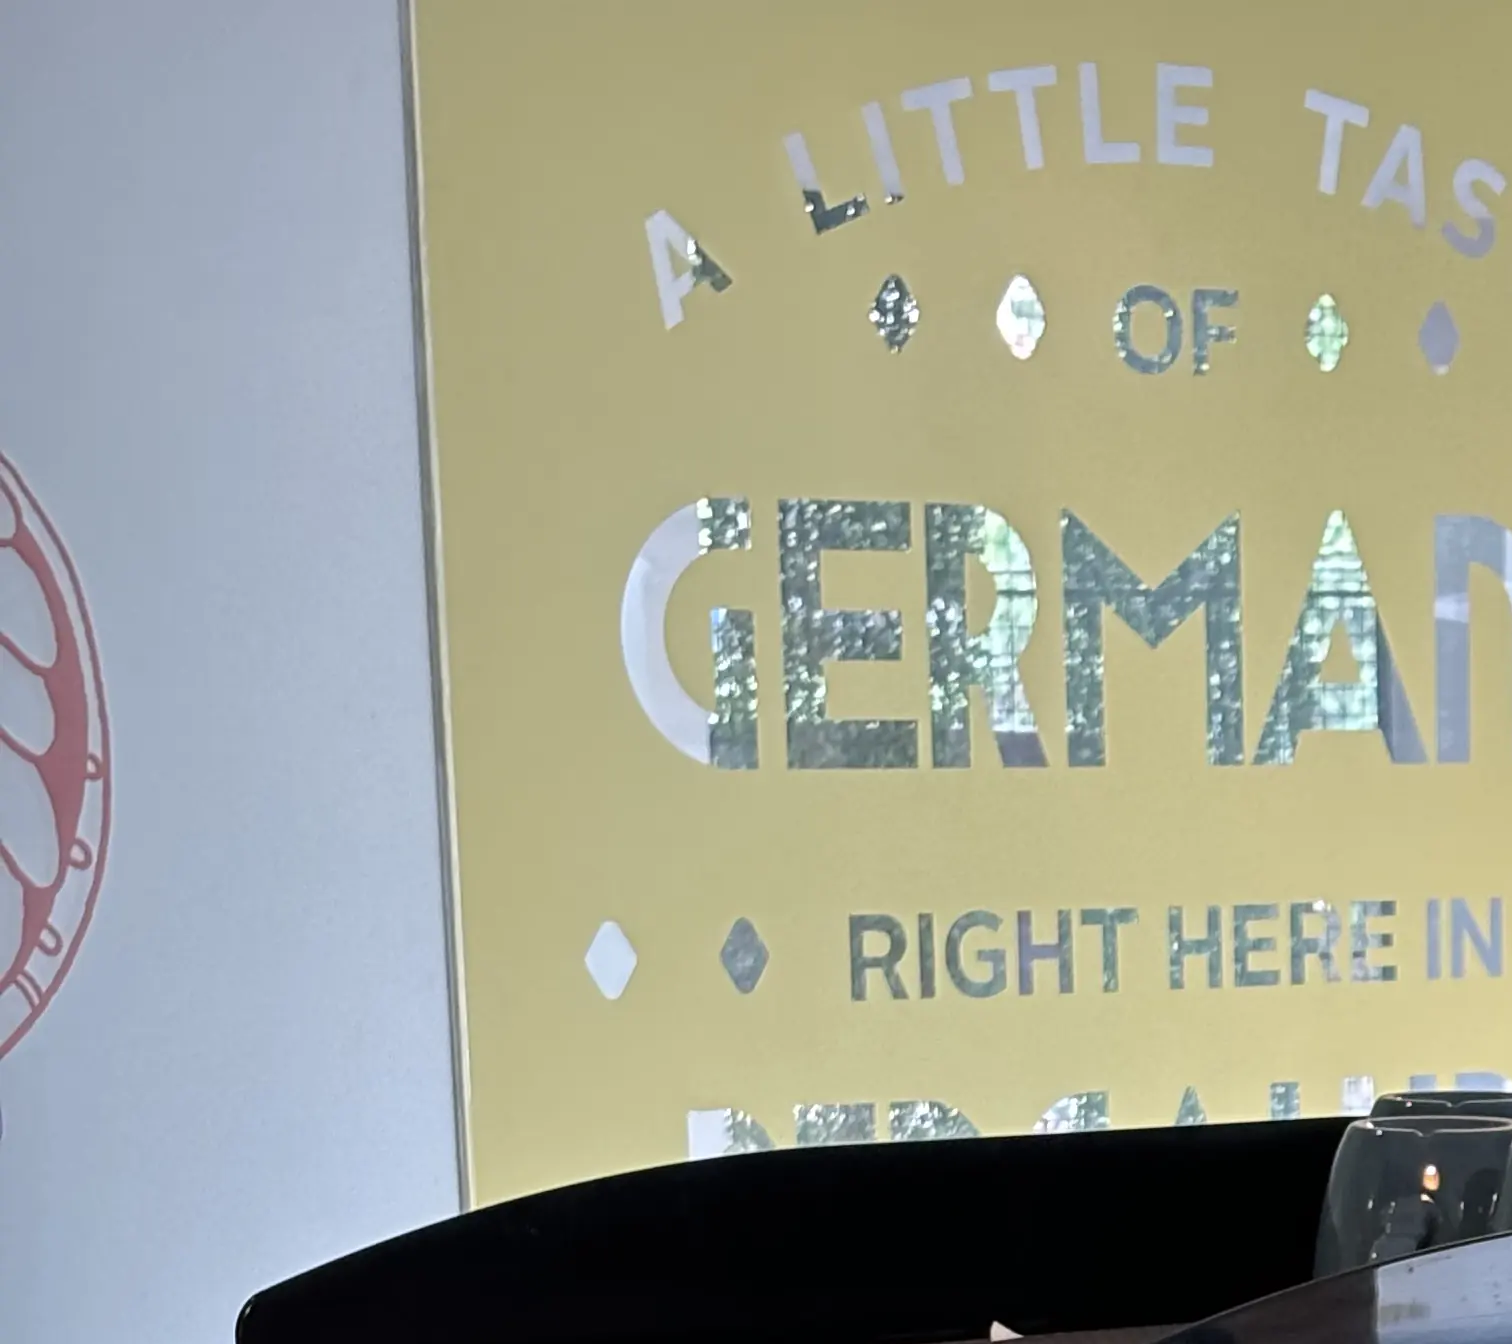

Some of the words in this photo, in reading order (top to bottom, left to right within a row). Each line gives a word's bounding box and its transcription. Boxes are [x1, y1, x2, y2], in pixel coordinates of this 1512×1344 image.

[643, 209, 732, 331] A
[783, 62, 1215, 235] LITTLE
[1112, 283, 1240, 376] OF
[848, 905, 1140, 1001] RIGHT
[1167, 899, 1398, 989] HERE
[1424, 896, 1504, 981] IN
